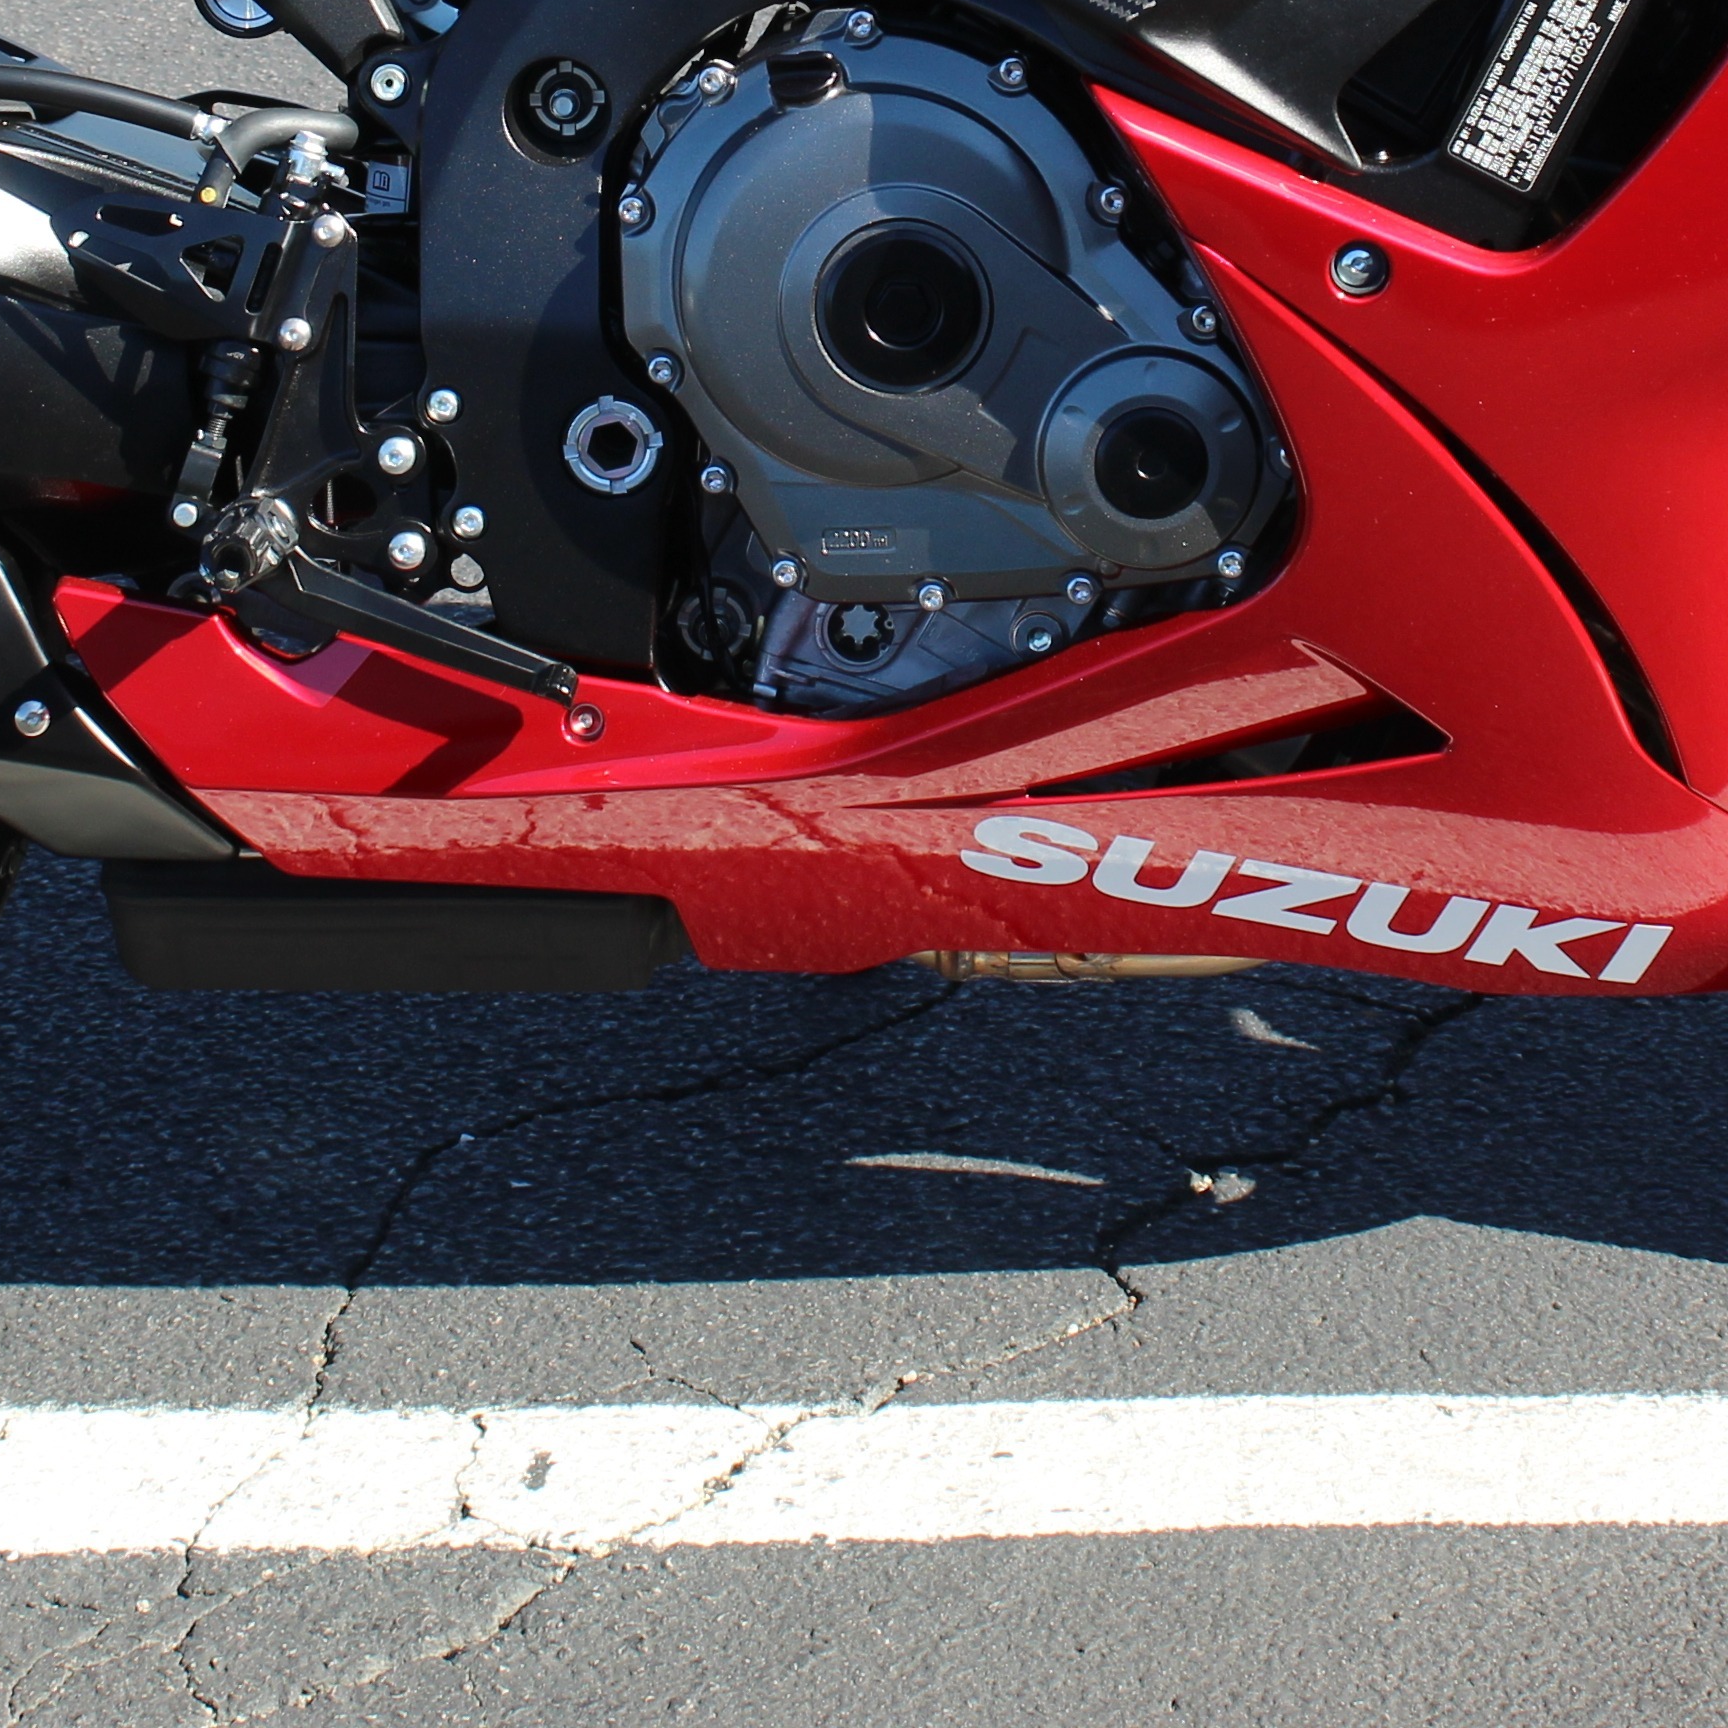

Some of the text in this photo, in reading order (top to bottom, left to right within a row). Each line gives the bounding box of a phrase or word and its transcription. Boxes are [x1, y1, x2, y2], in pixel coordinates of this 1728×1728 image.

[1607, 0, 1626, 23] MADE
[1465, 93, 1489, 127] SUZUKI
[1483, 62, 1506, 92] MOTOR
[1500, 1, 1538, 61] CORPORATION
[1523, 129, 1558, 184] MOTORCYCLE
[961, 815, 1673, 984] SUZUKI
